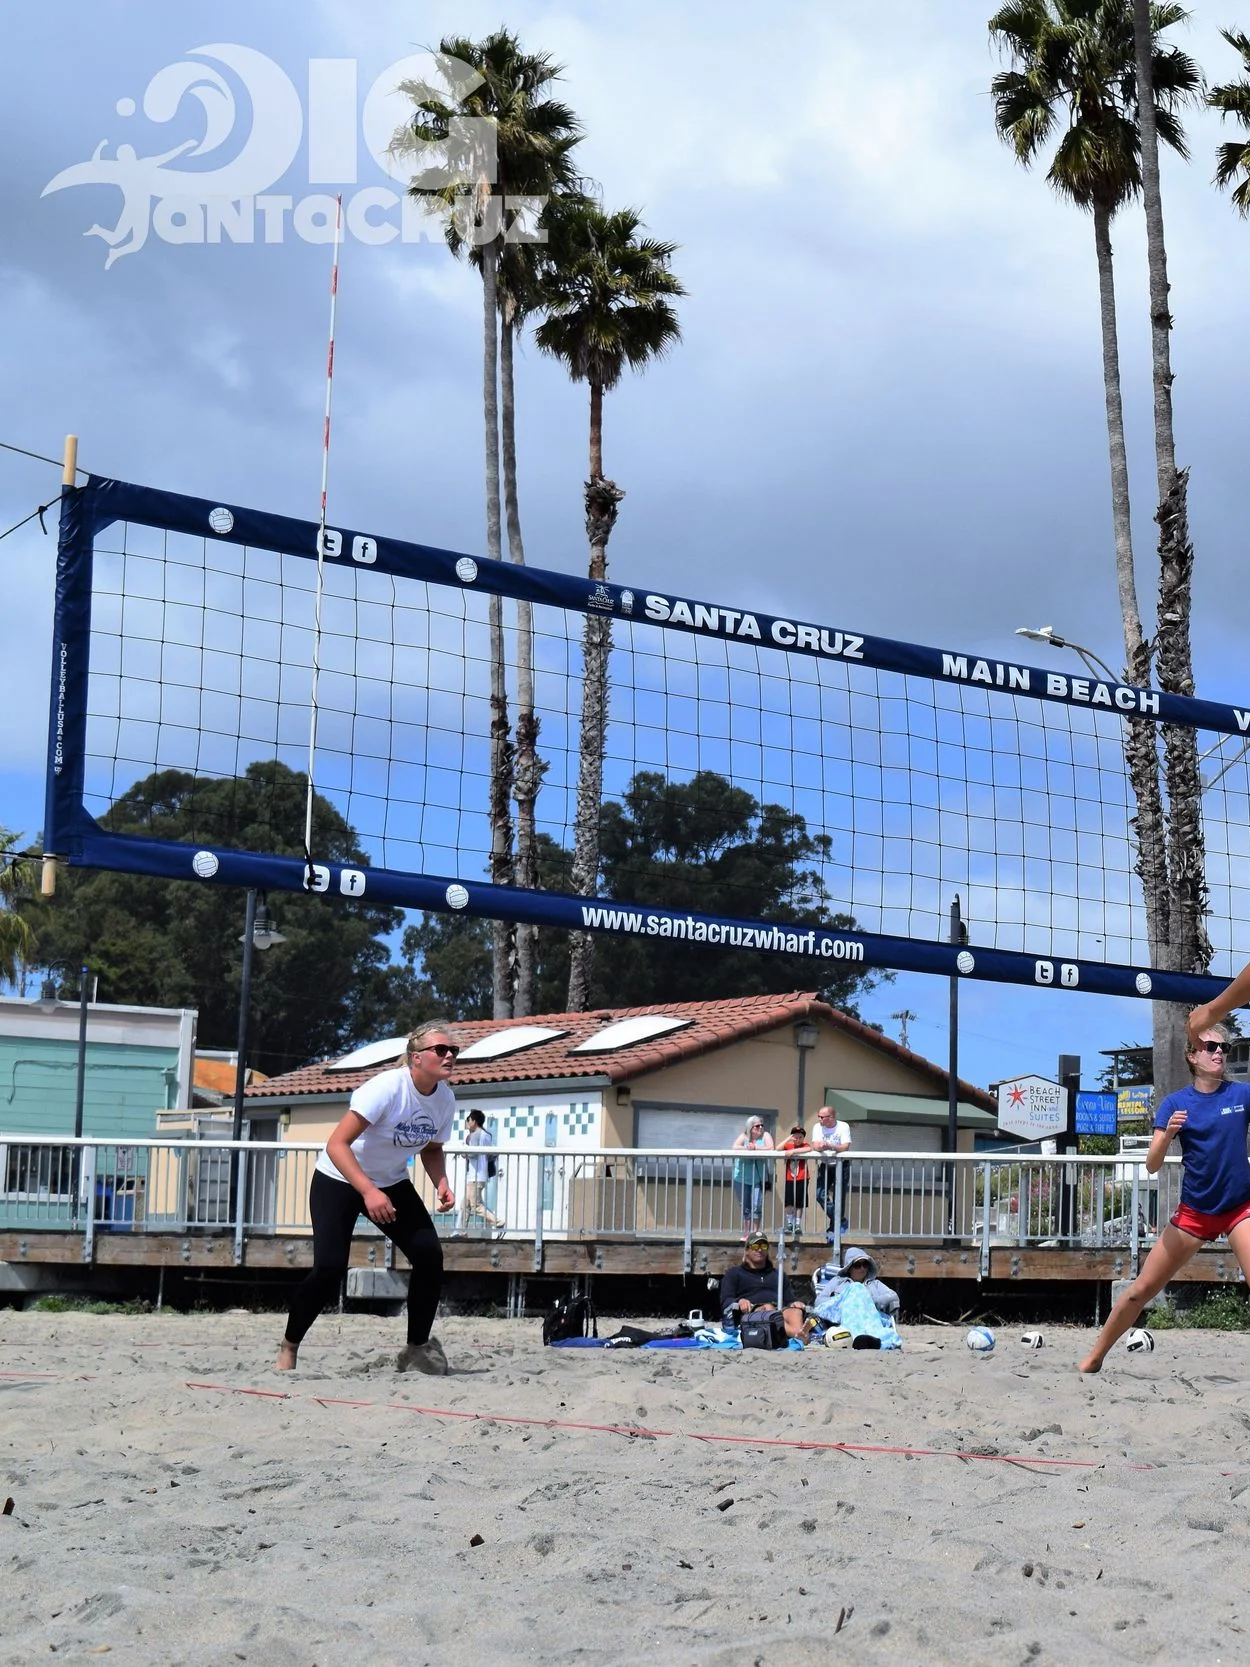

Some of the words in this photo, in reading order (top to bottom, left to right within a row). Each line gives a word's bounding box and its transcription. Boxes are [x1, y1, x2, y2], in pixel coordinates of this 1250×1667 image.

[645, 595, 762, 639] SANTA
[771, 620, 864, 659] CRUZ
[942, 653, 1030, 691] MAIN
[1046, 673, 1160, 715] BEACH
[582, 906, 864, 961] www.santacruzwharf.com
[1030, 1086, 1061, 1095] BEACH
[1030, 1095, 1060, 1104] STREET
[1031, 1104, 1047, 1112] INN
[1029, 1112, 1060, 1122] SUITES
